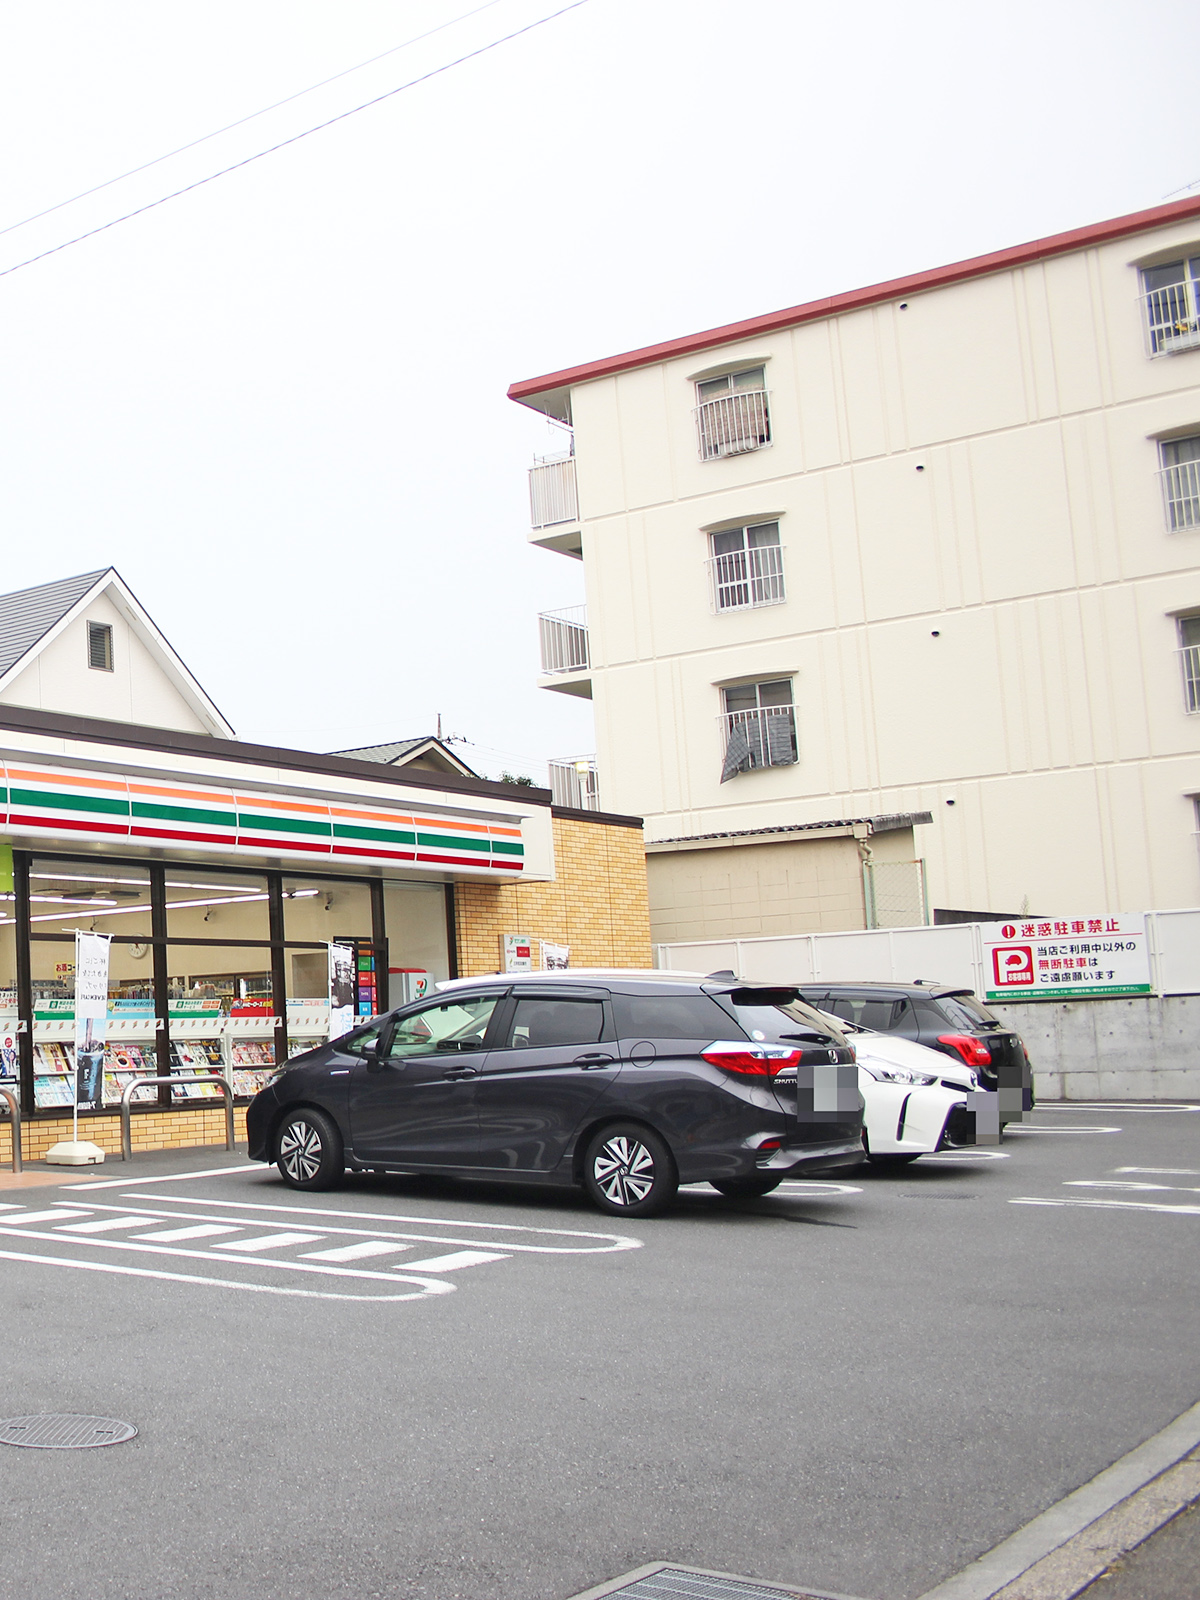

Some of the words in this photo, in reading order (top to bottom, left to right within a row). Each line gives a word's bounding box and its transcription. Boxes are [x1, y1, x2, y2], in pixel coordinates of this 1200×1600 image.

[1021, 918, 1121, 938] 迷惑駐車禁止
[1037, 941, 1137, 957] 当店ご利用中以外の
[1038, 957, 1099, 971] 無断駐車は
[1039, 970, 1116, 983] ご遠慮願います
